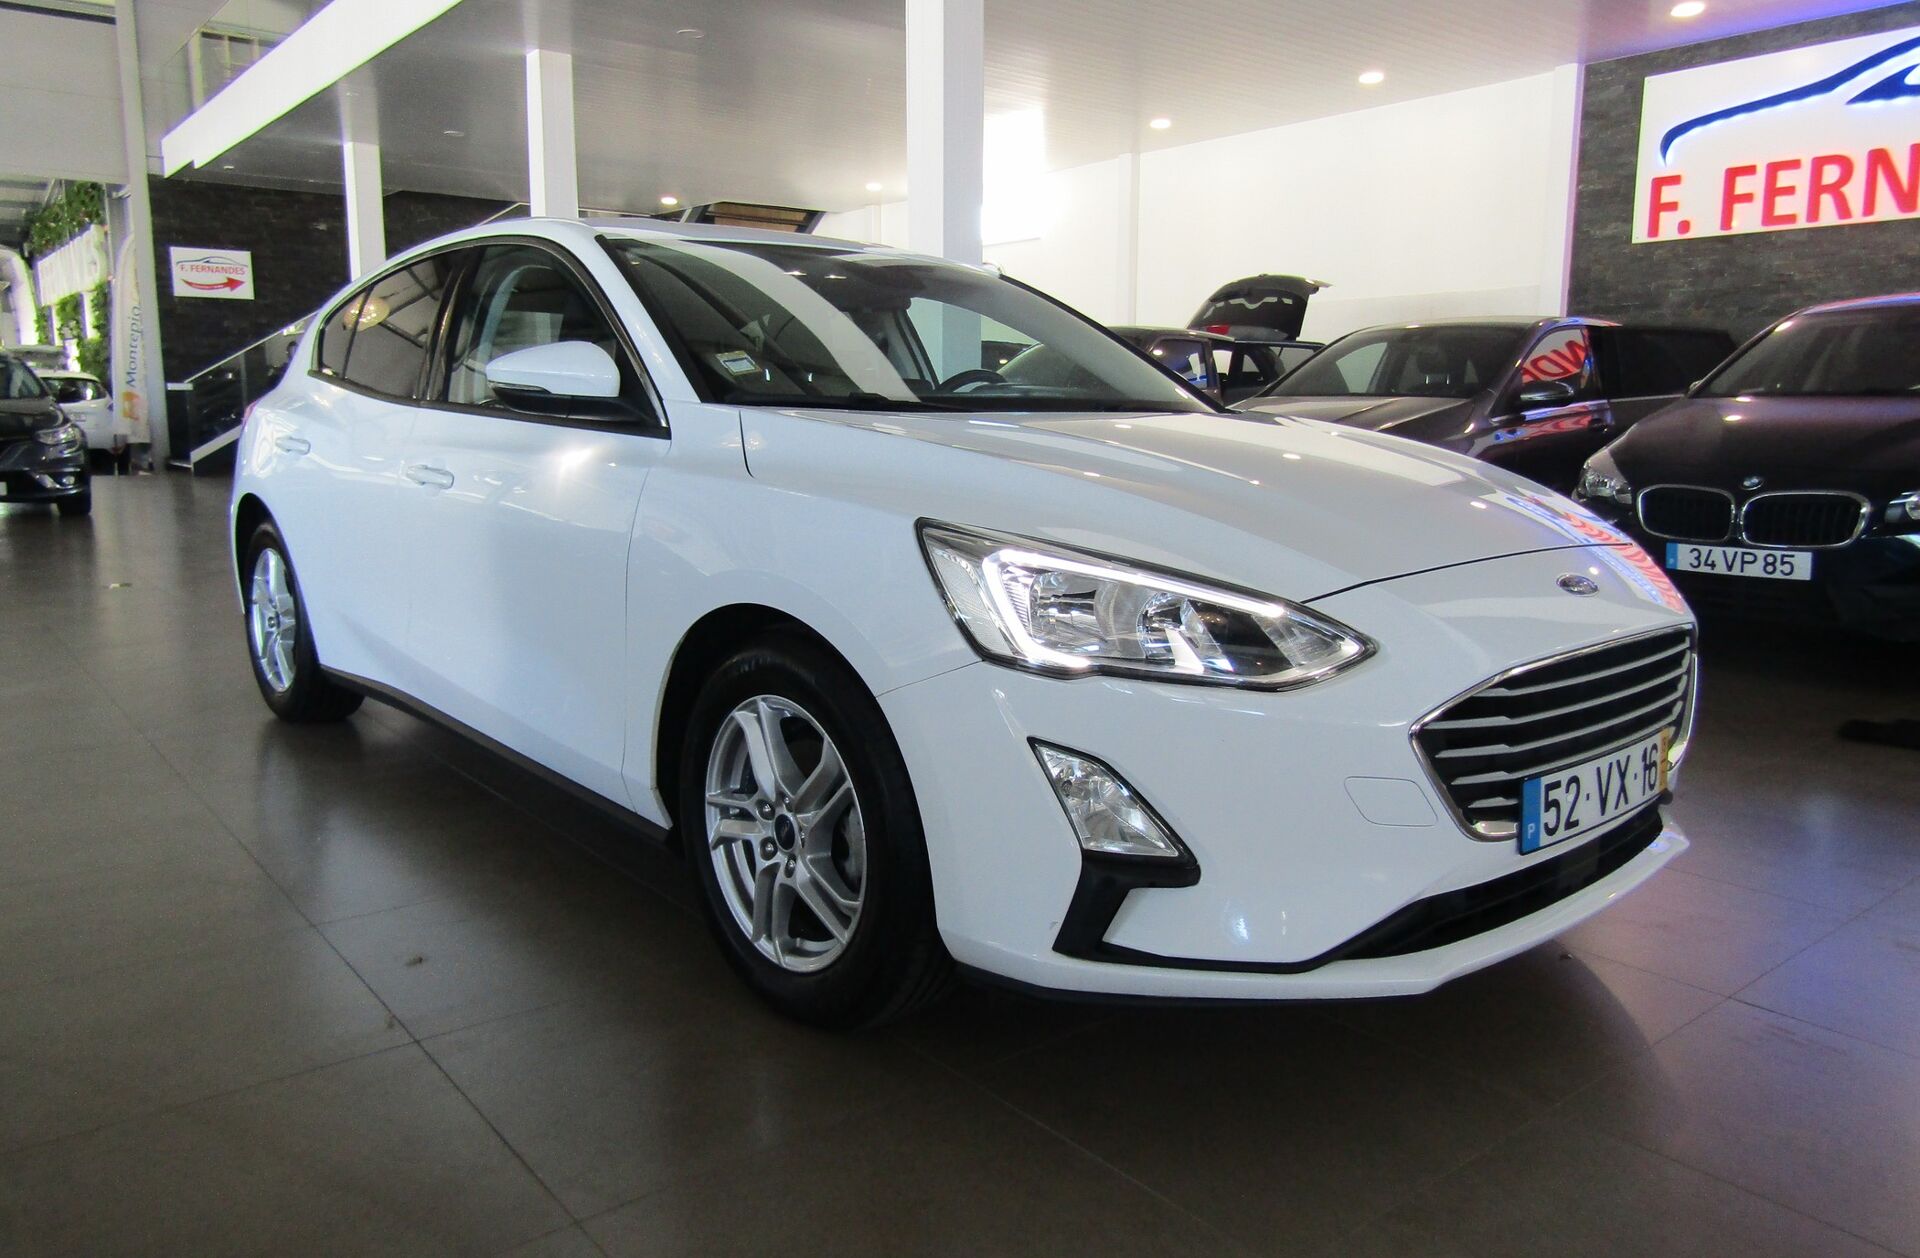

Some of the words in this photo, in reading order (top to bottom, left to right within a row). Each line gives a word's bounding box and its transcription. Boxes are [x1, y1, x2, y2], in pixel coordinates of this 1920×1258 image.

[1647, 175, 1690, 238] F.
[190, 264, 246, 276] FERNANDES
[126, 305, 143, 389] Montepio
[1527, 823, 1535, 839] P
